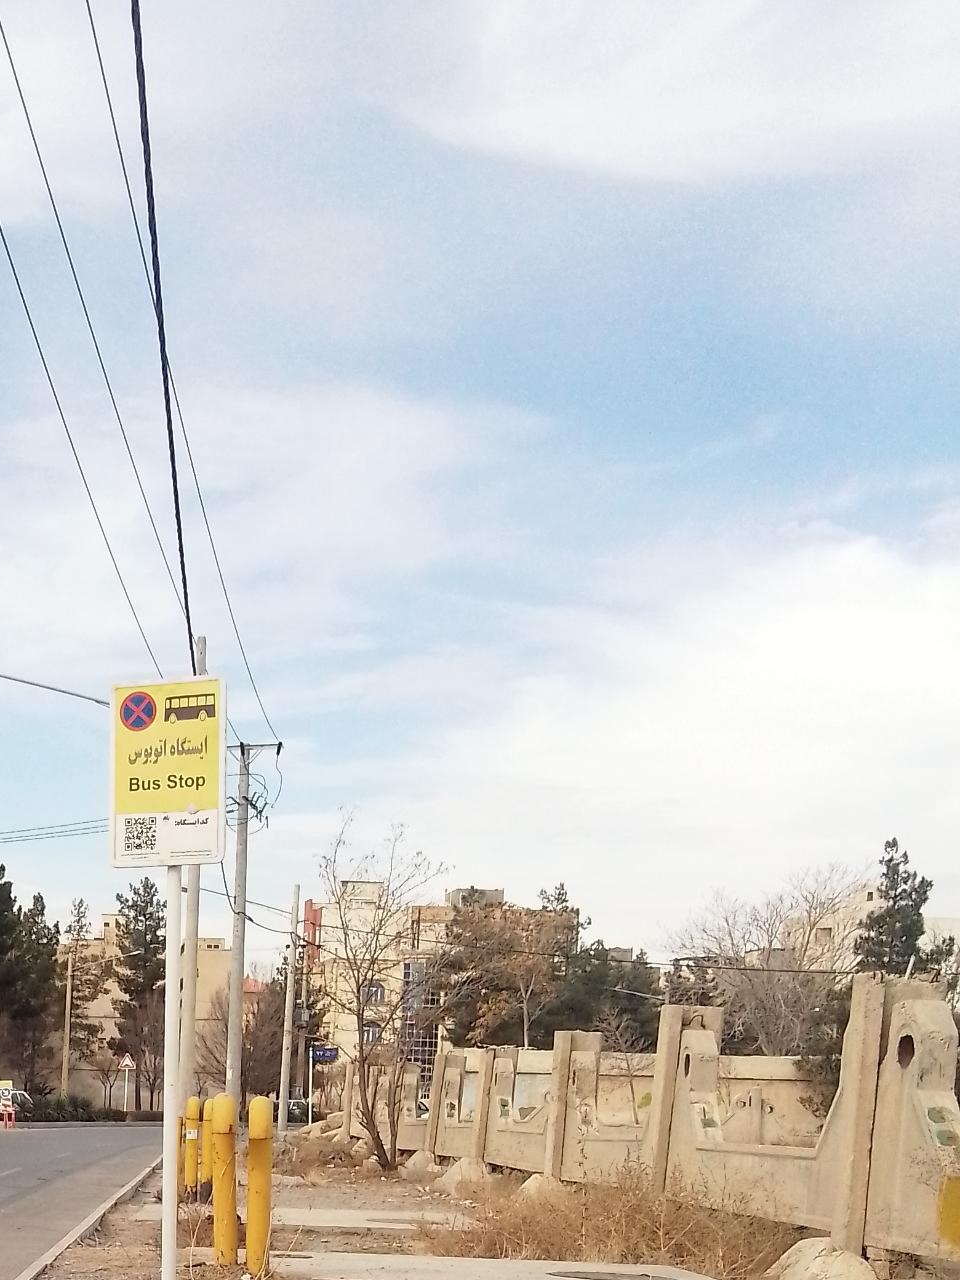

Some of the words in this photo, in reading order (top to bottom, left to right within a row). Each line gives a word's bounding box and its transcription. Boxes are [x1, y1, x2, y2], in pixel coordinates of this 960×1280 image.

[128, 738, 167, 765] اتوبوس
[170, 735, 208, 759] ایستگاه
[129, 777, 161, 791] Bus
[167, 774, 206, 790] Stop
